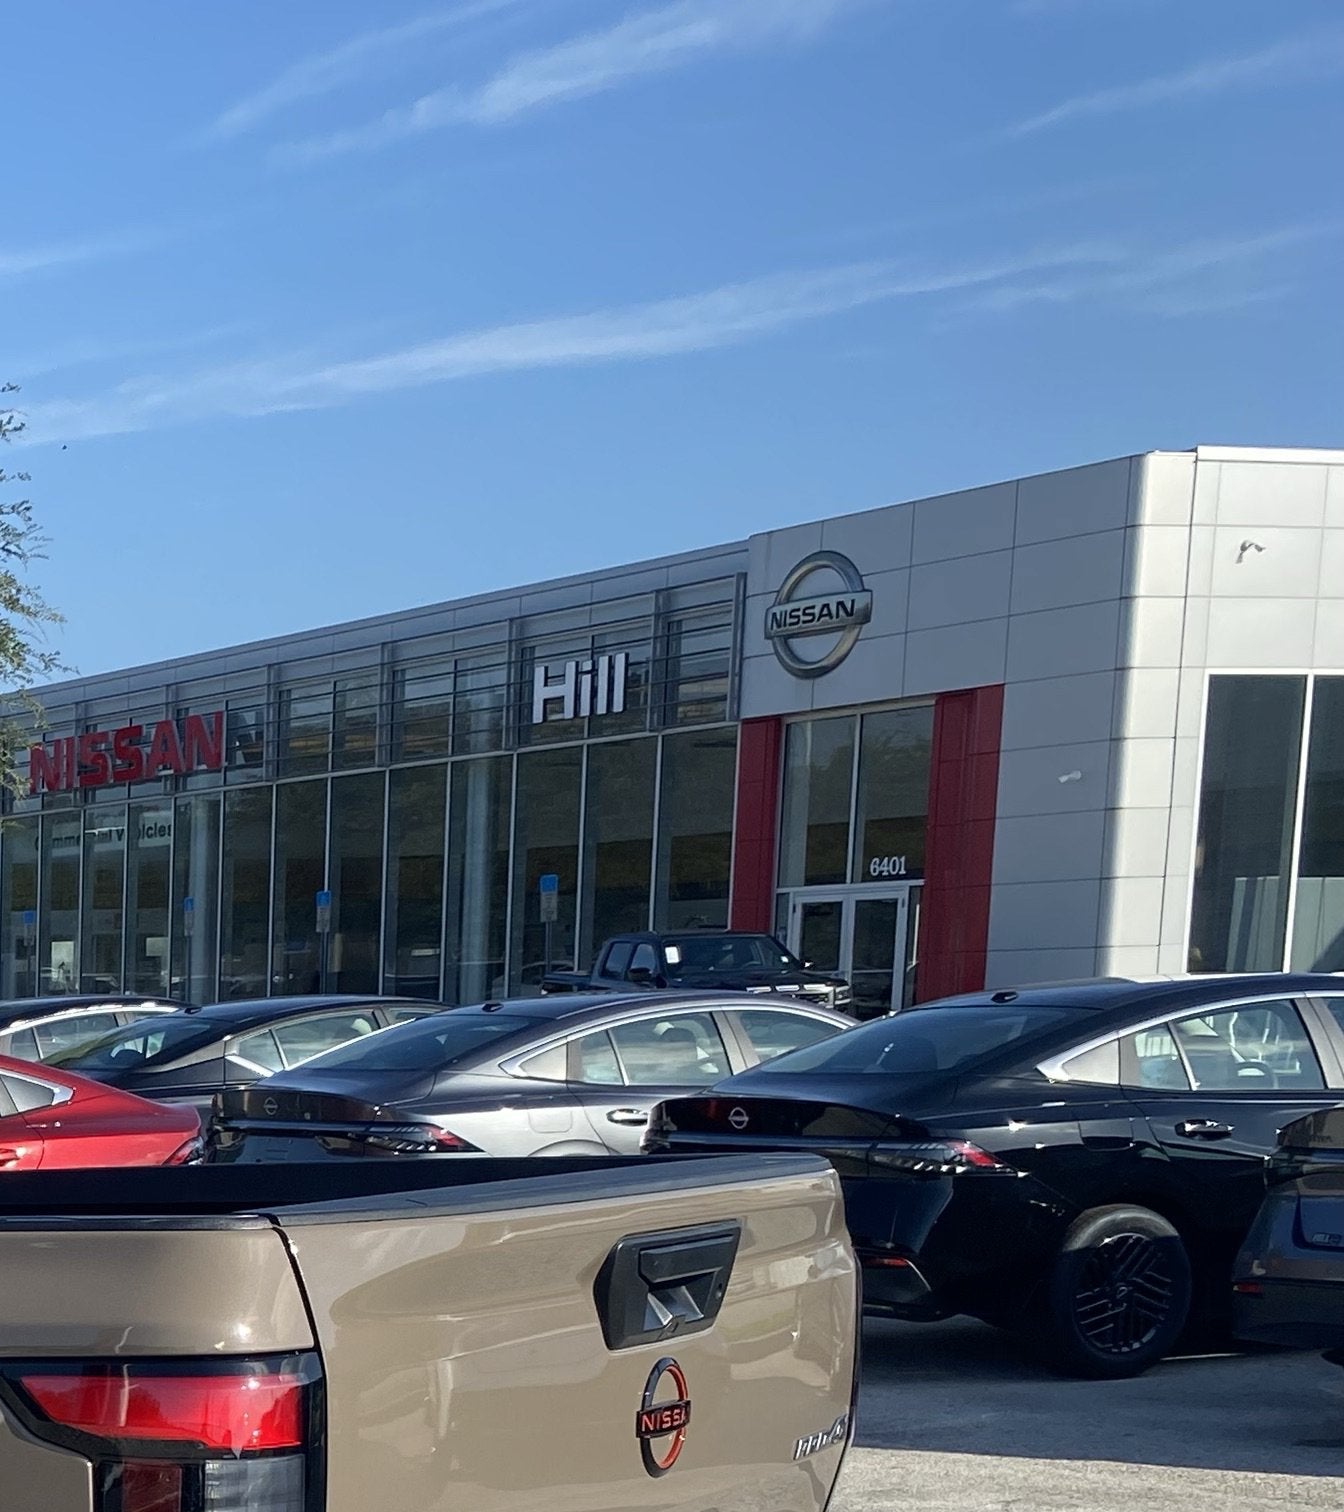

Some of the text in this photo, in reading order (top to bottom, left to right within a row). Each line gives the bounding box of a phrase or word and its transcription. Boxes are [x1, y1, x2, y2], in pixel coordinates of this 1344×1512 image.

[770, 599, 856, 630] NISSAN
[532, 652, 627, 724] Hill
[29, 711, 224, 795] NISSAN
[870, 855, 907, 877] 6401
